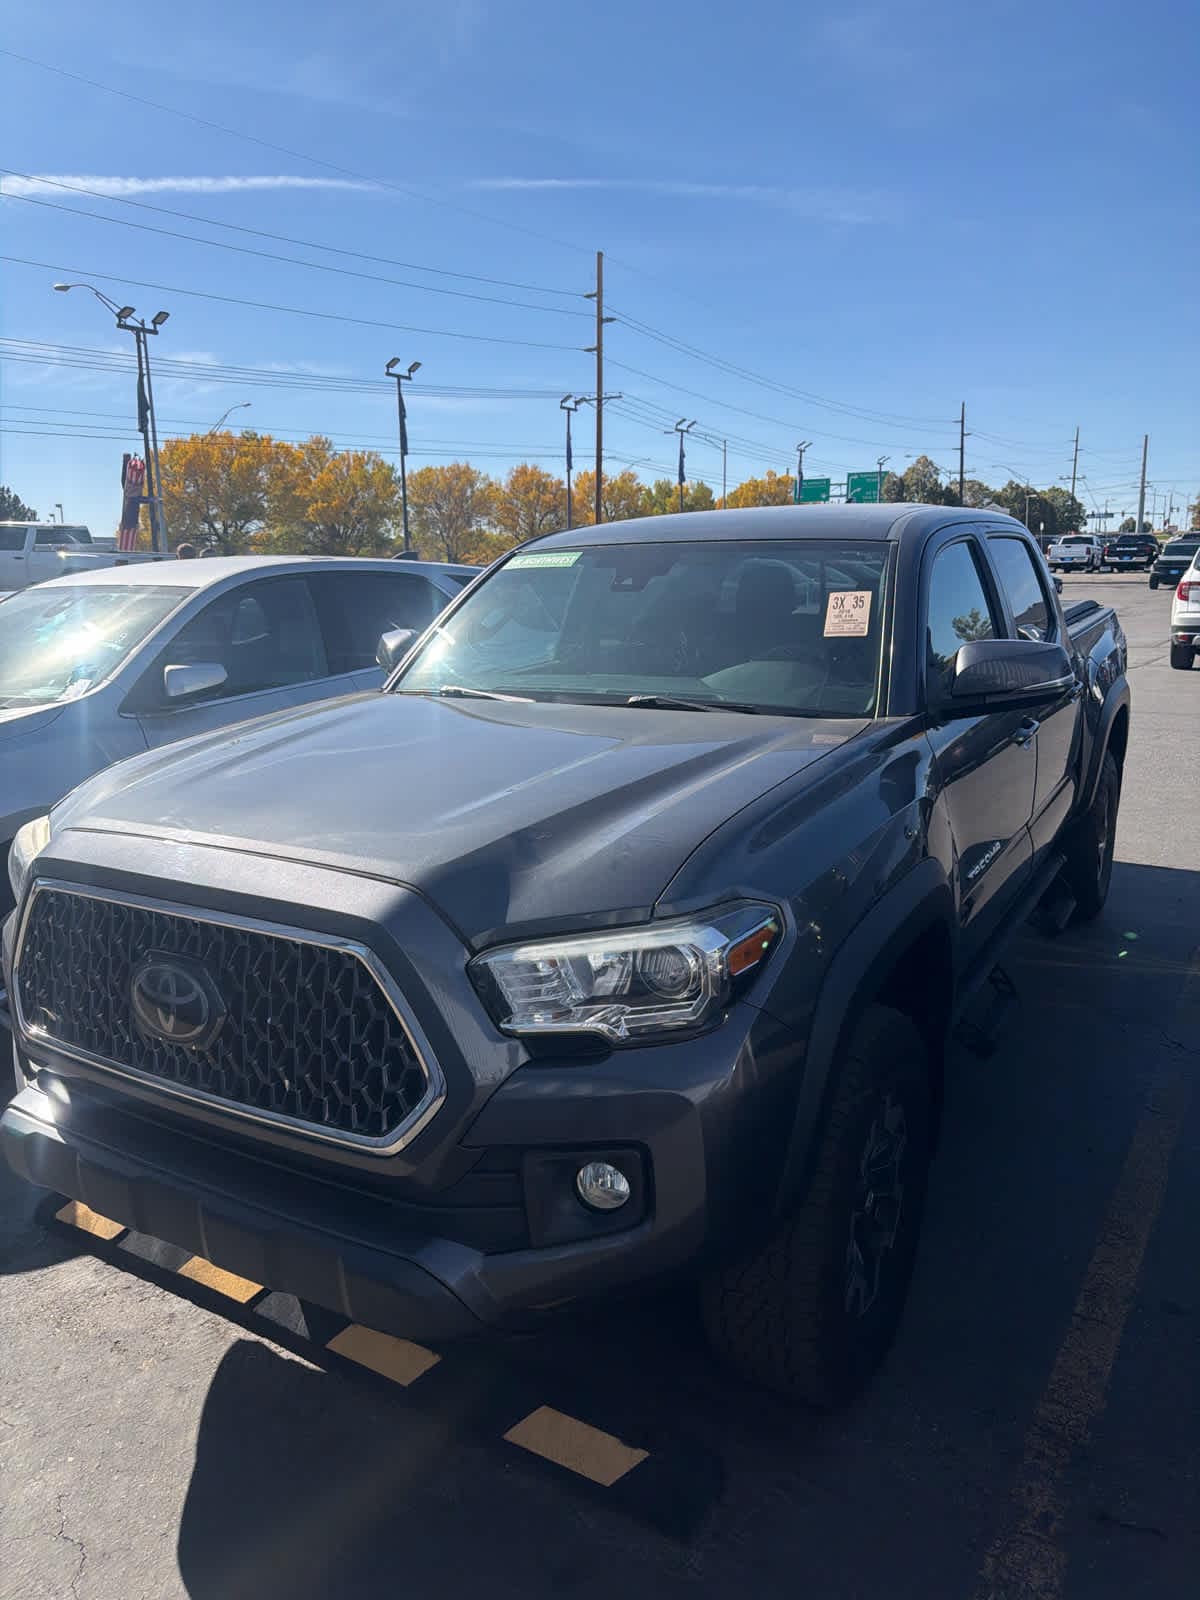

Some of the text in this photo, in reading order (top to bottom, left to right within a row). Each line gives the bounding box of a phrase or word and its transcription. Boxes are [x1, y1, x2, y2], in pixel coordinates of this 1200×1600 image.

[832, 595, 865, 609] 3X 35
[967, 841, 1001, 878] TACOMA
